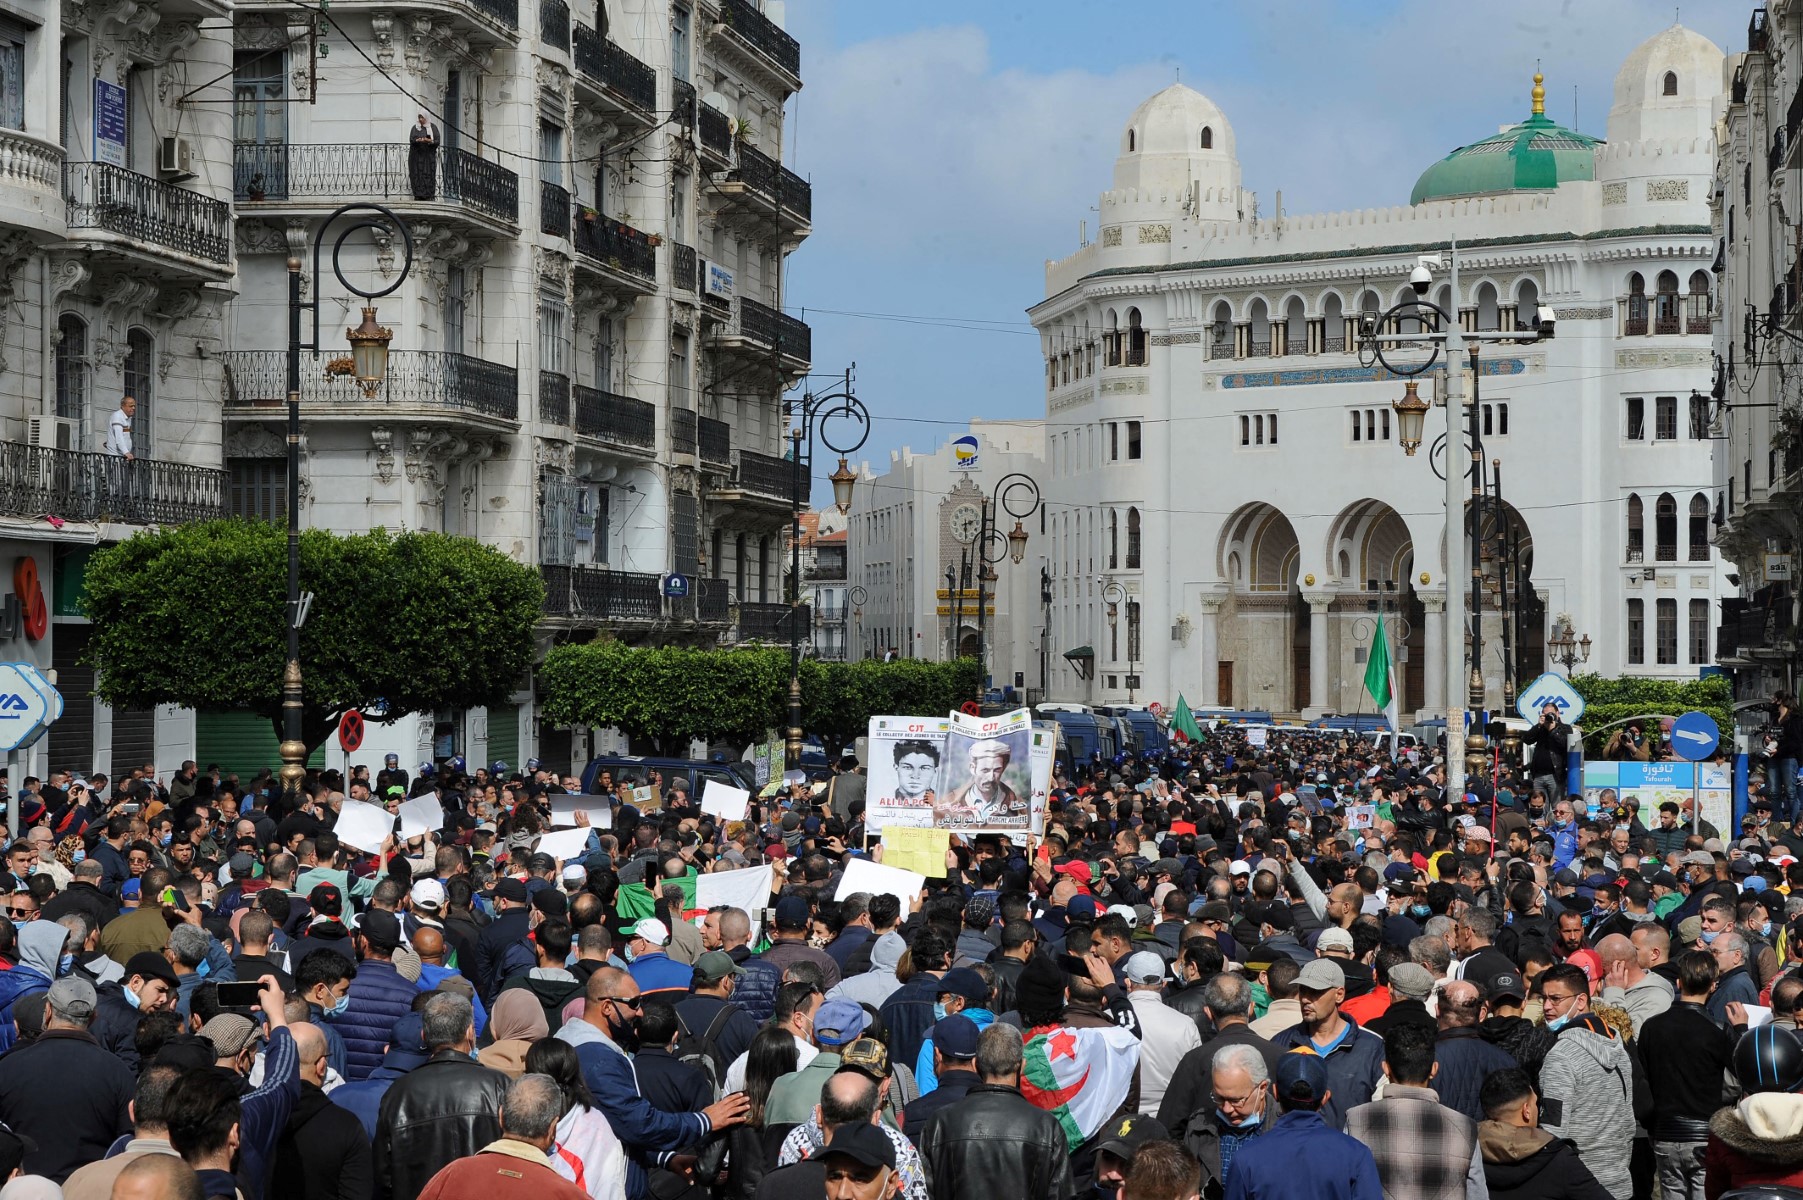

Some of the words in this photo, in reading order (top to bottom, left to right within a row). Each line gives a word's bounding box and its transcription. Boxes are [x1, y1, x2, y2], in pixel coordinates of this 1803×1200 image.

[983, 722, 999, 732] CJT
[1642, 764, 1674, 776] تافورة
[879, 798, 895, 806] ALI
[897, 798, 910, 806] LA
